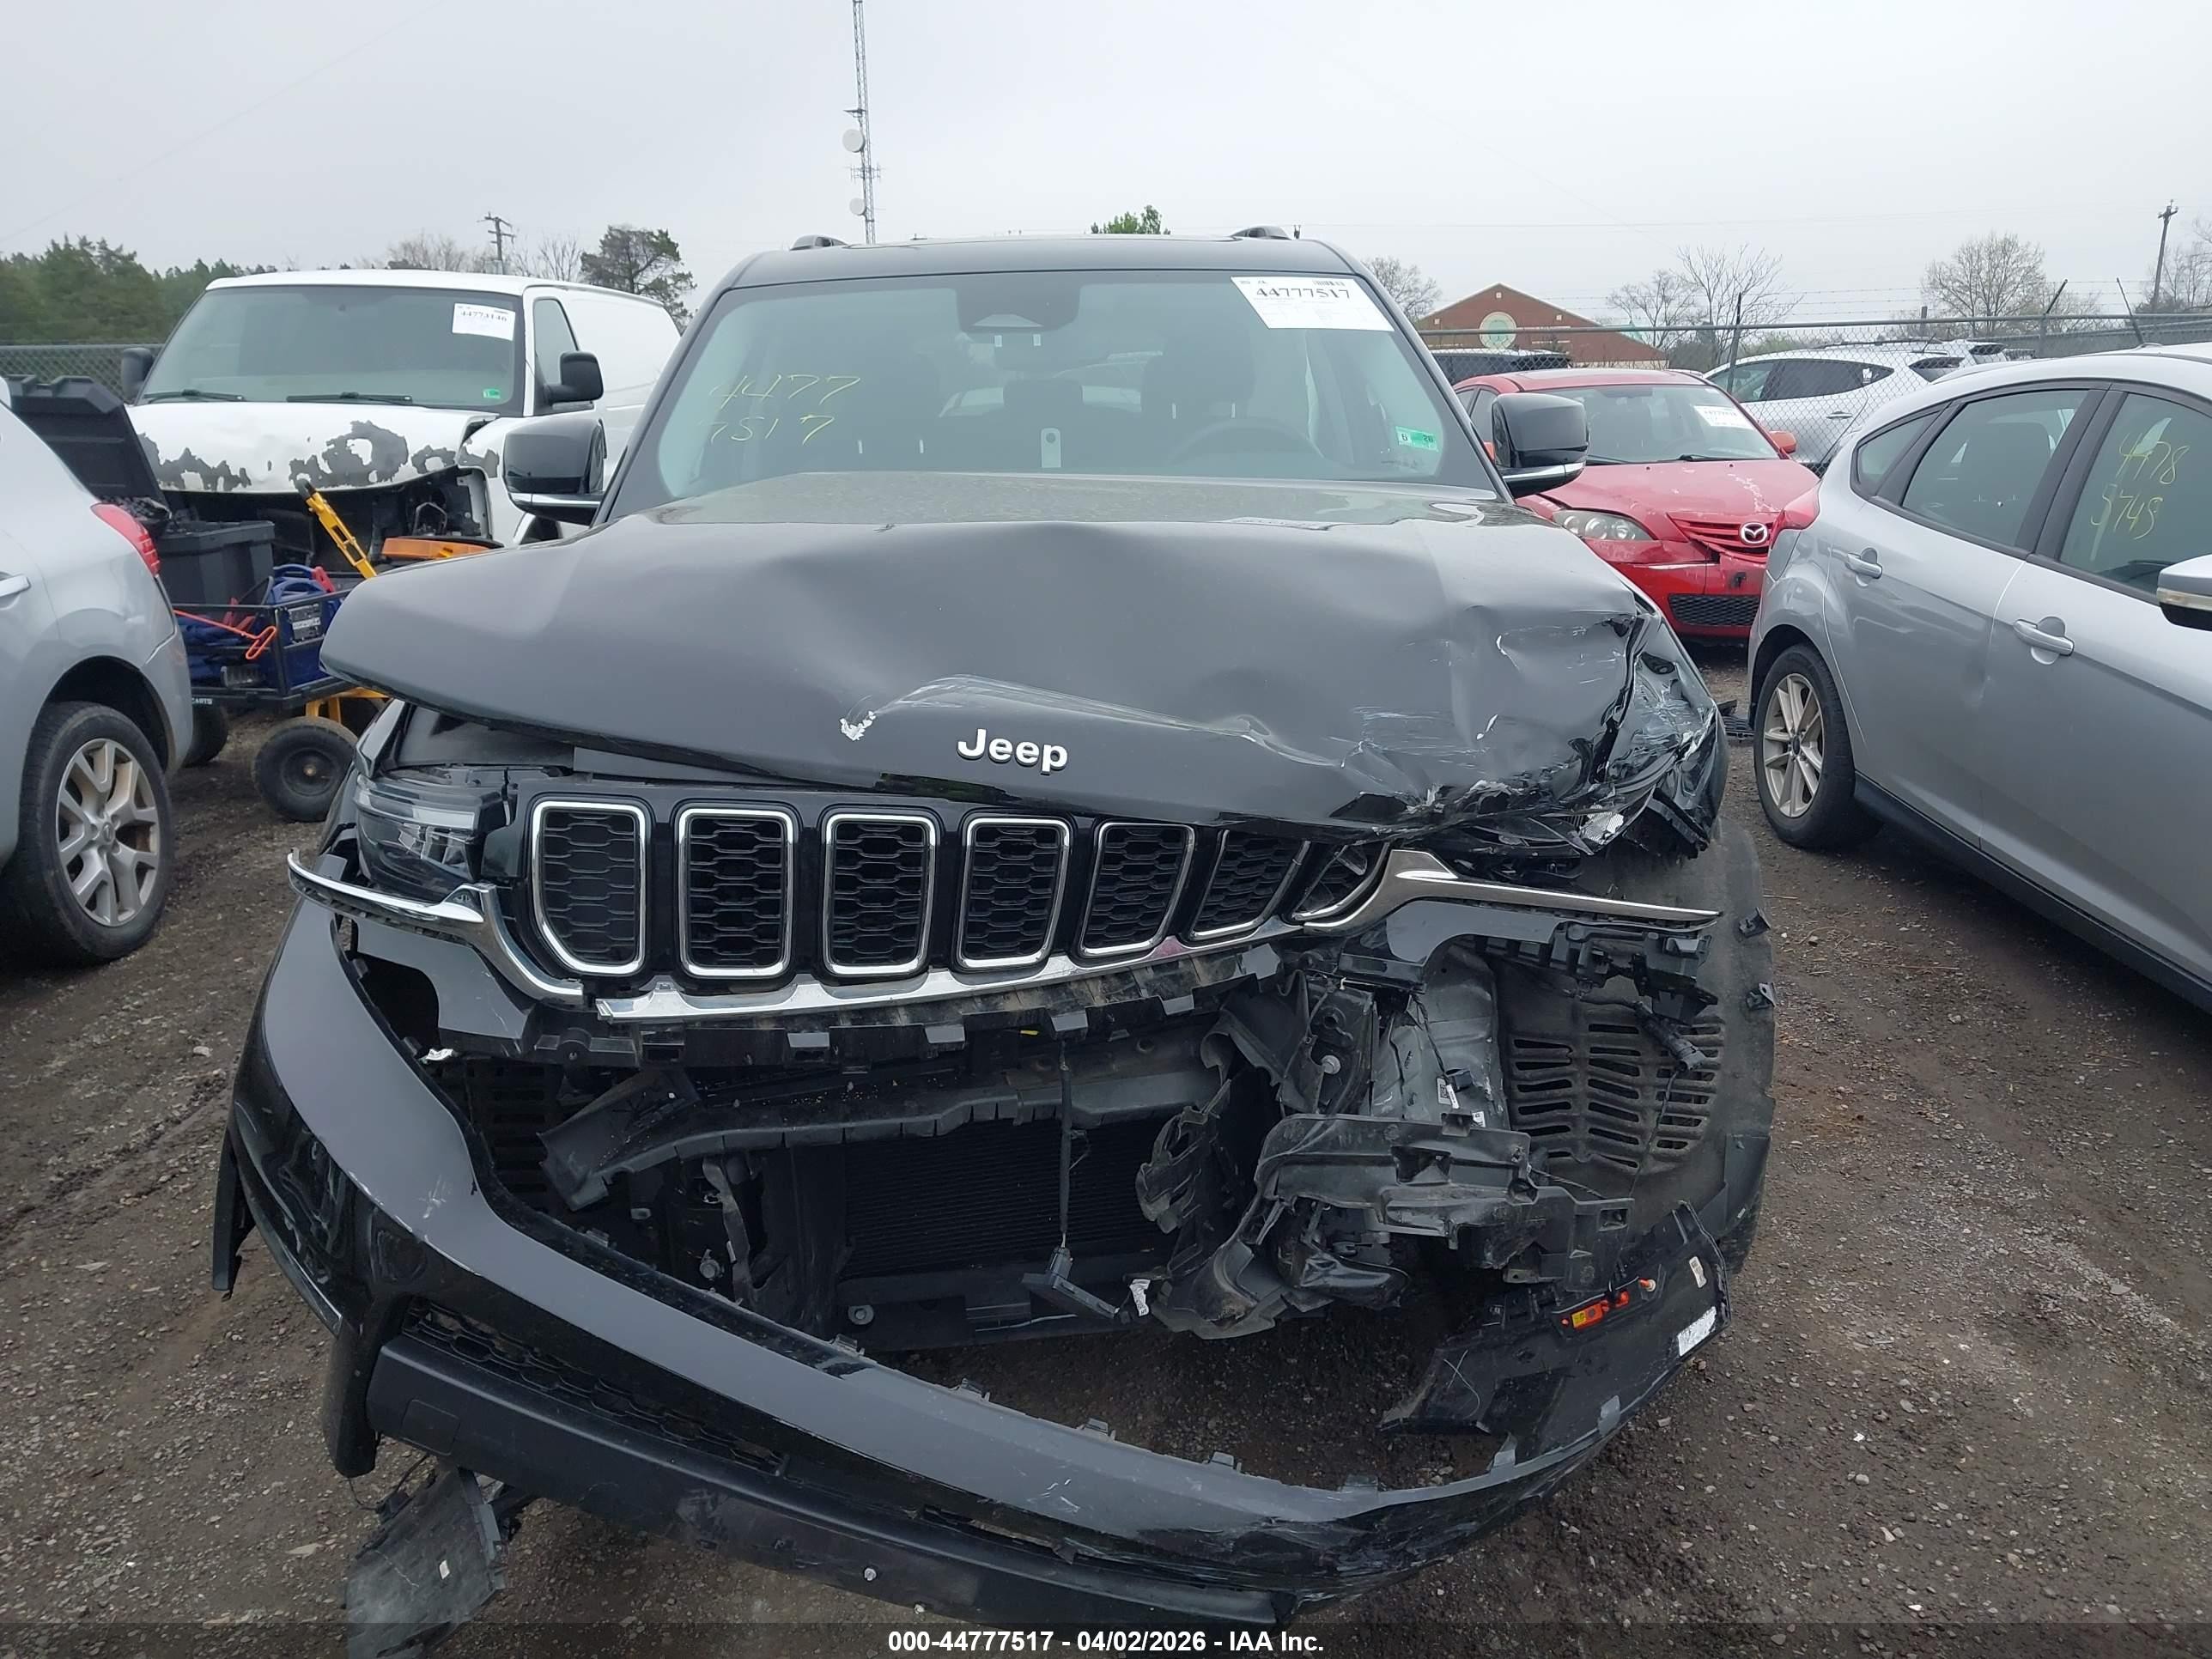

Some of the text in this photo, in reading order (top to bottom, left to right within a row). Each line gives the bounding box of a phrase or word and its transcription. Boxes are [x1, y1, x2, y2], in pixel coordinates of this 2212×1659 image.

[1256, 288, 1350, 299] 44777517
[708, 374, 860, 410] 4477
[698, 414, 836, 445] 7517
[957, 728, 1068, 776] Jeep
